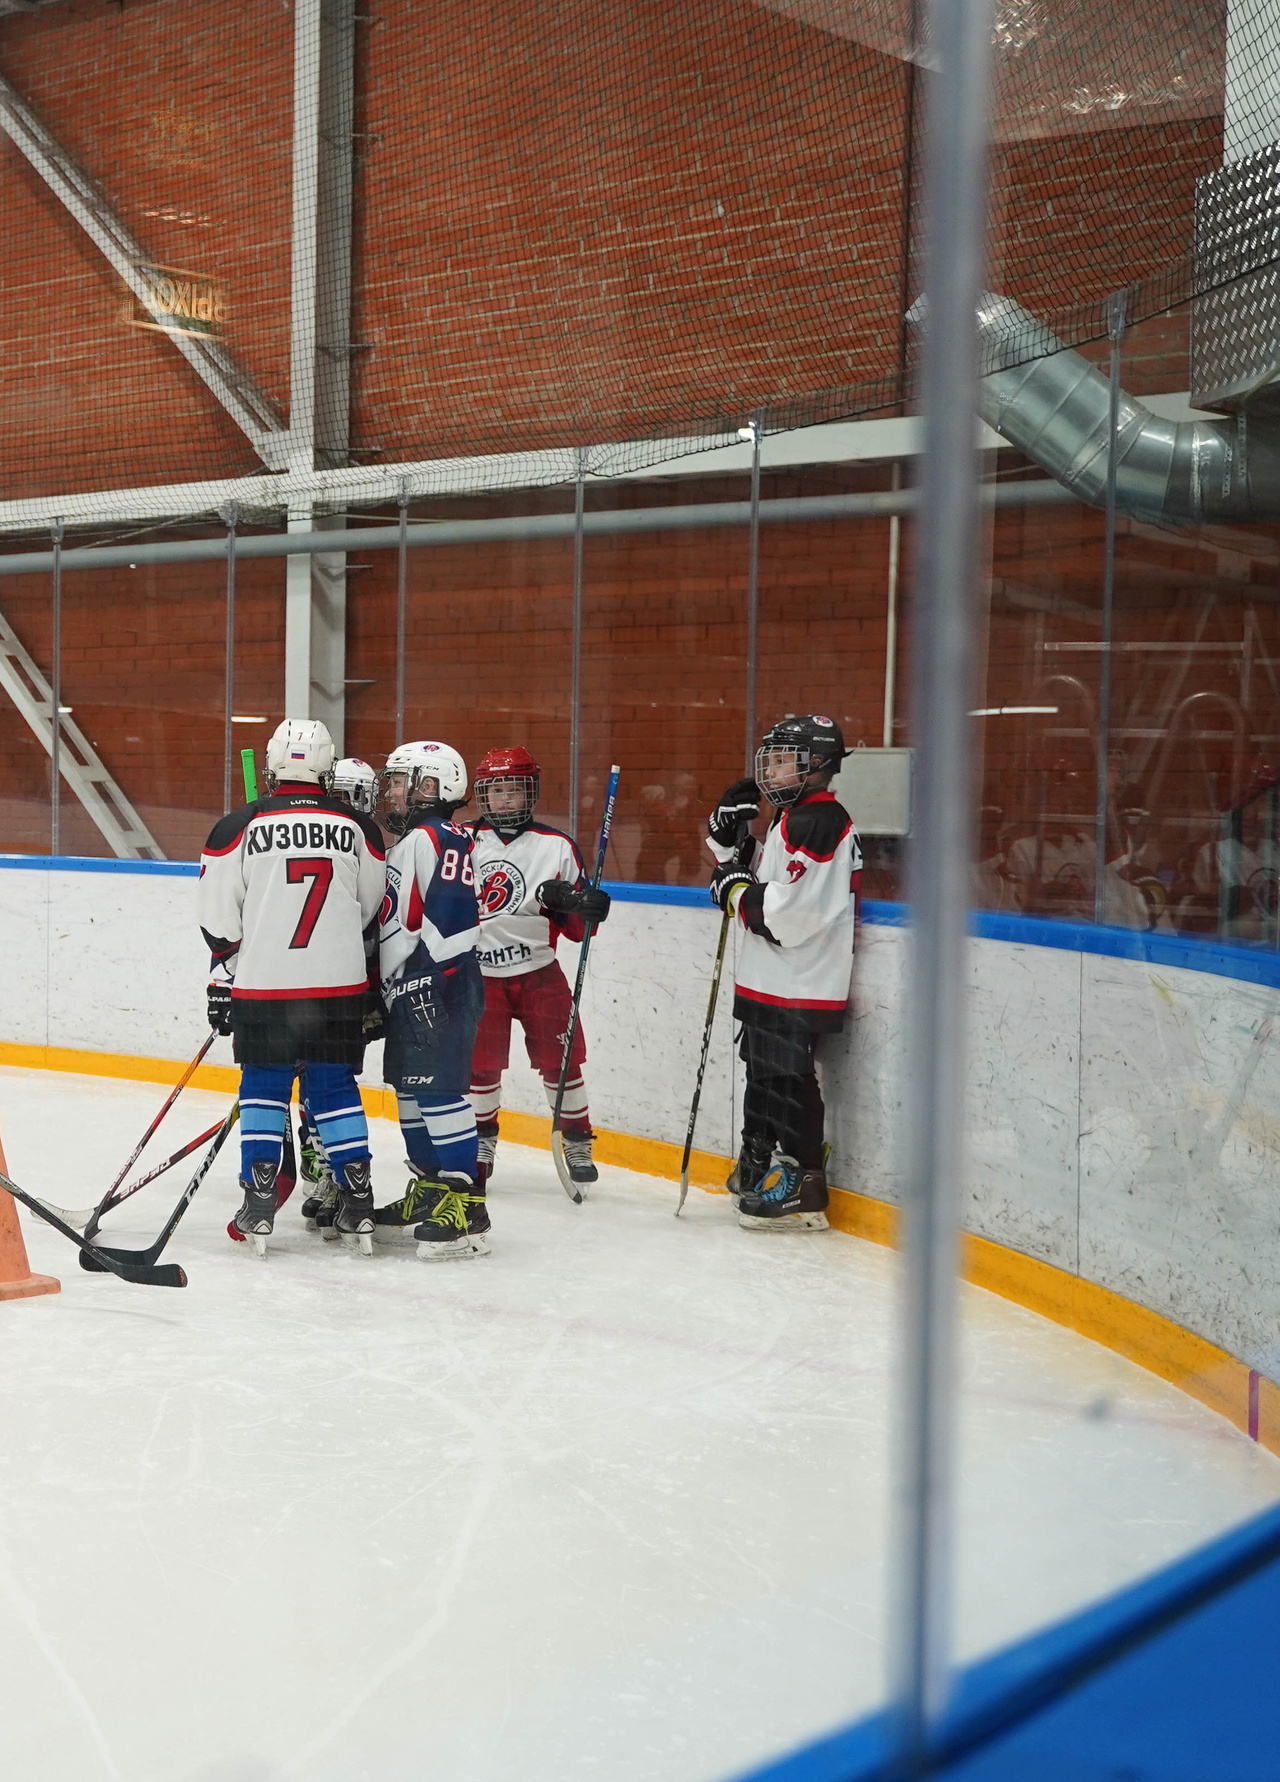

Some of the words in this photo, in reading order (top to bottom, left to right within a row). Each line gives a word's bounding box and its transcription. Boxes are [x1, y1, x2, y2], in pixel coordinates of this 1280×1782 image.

[297, 731, 304, 741] 7
[440, 848, 475, 887] 88
[286, 857, 334, 949] 7
[389, 975, 433, 1000] AUER
[401, 1075, 435, 1085] CCM
[185, 1146, 218, 1204] CCM
